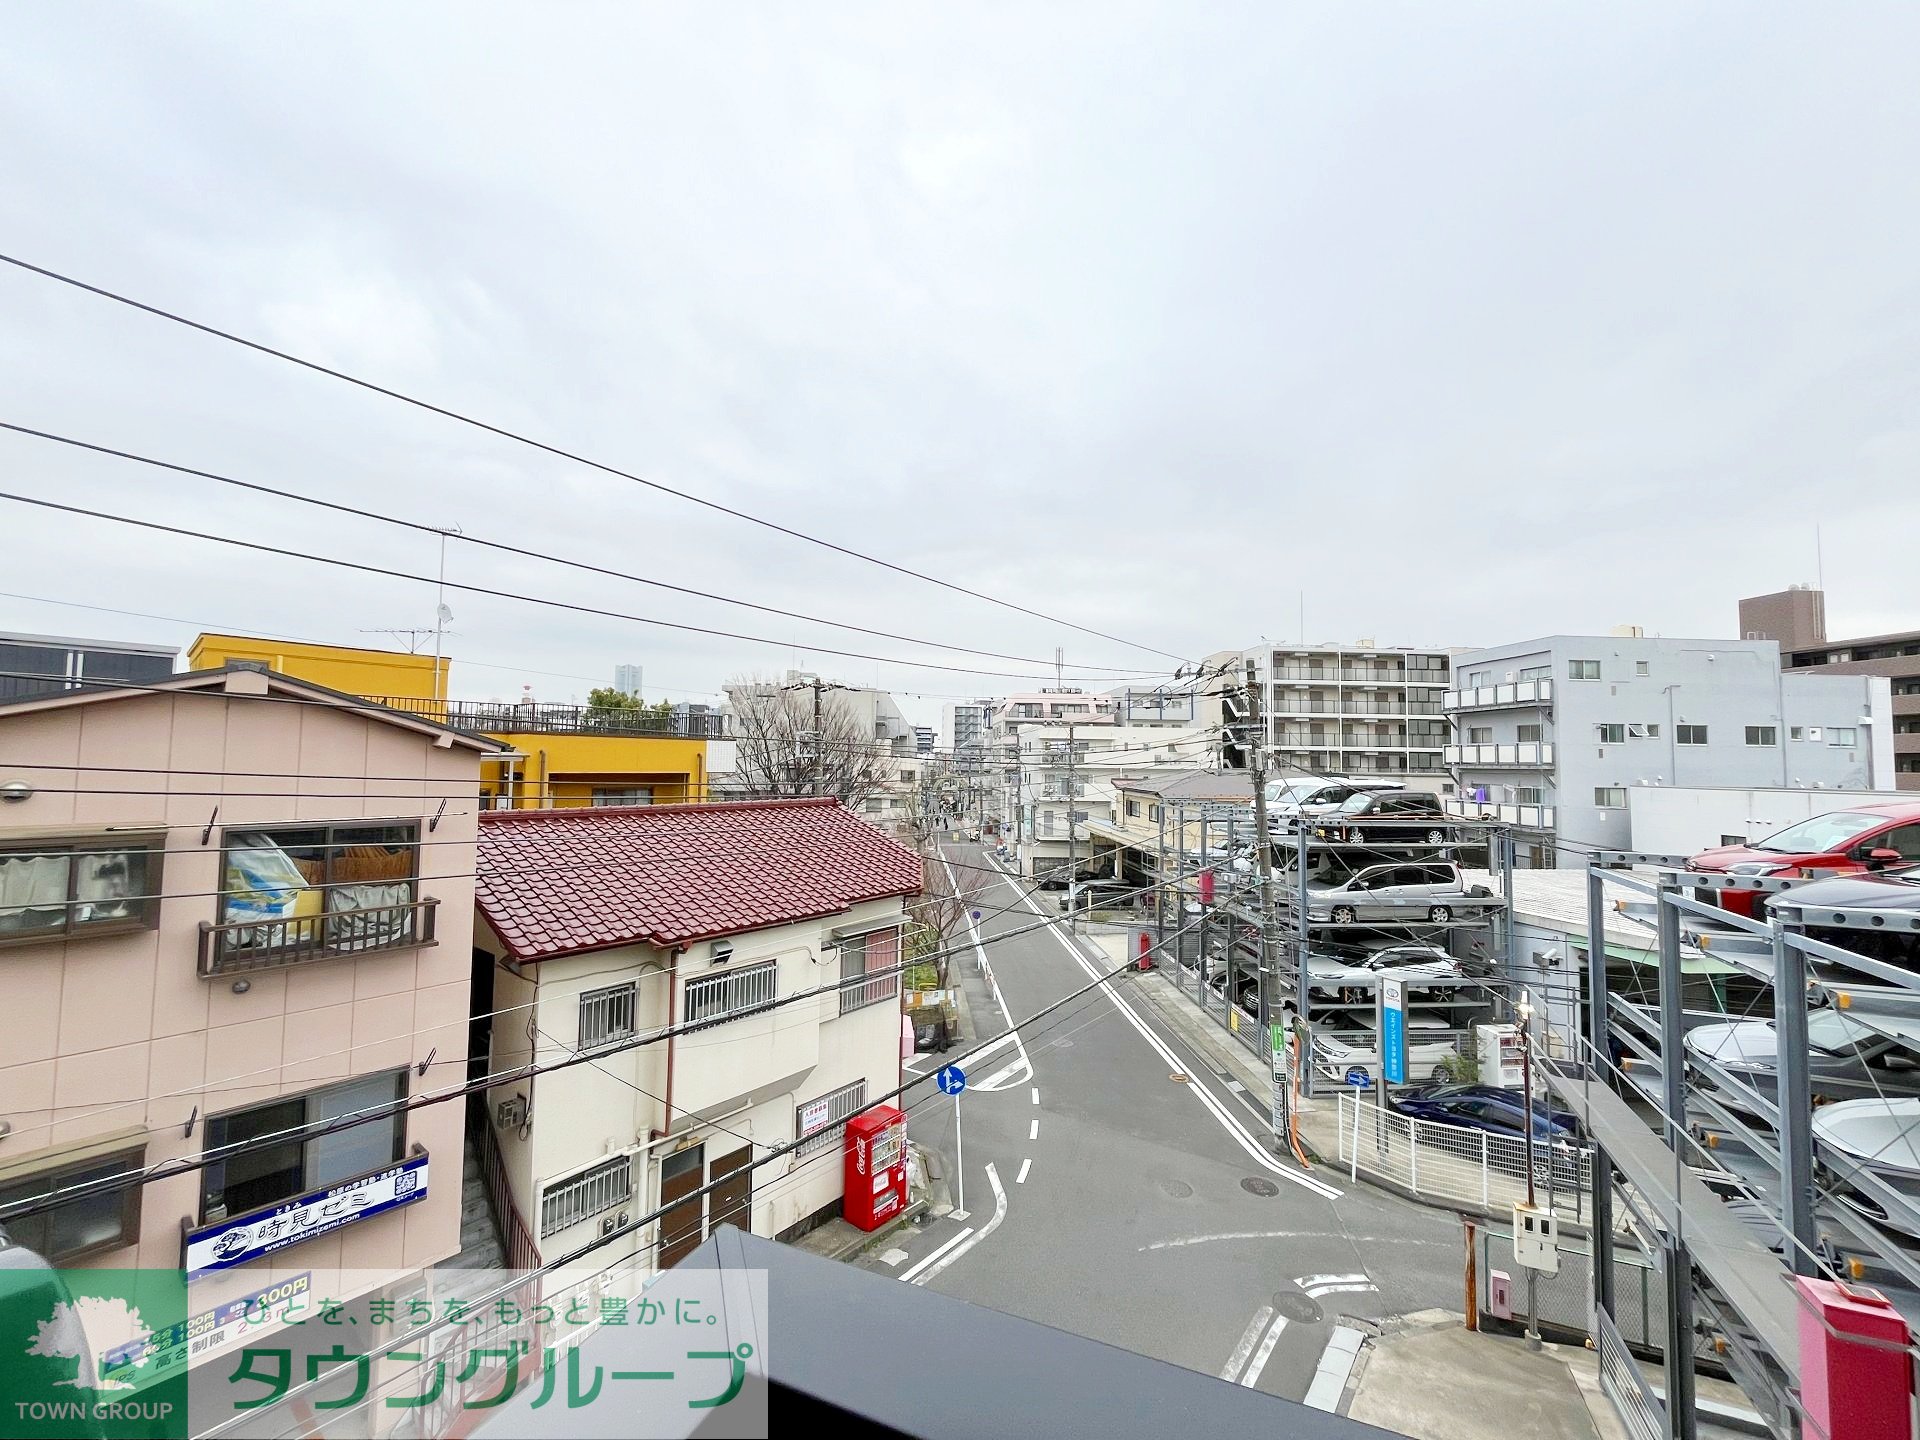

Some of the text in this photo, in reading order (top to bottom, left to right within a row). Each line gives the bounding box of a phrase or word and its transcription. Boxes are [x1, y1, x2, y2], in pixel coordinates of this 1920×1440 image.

[257, 1191, 374, 1240] 時見ゼミ
[264, 1212, 361, 1252] www.tokimizemi.com
